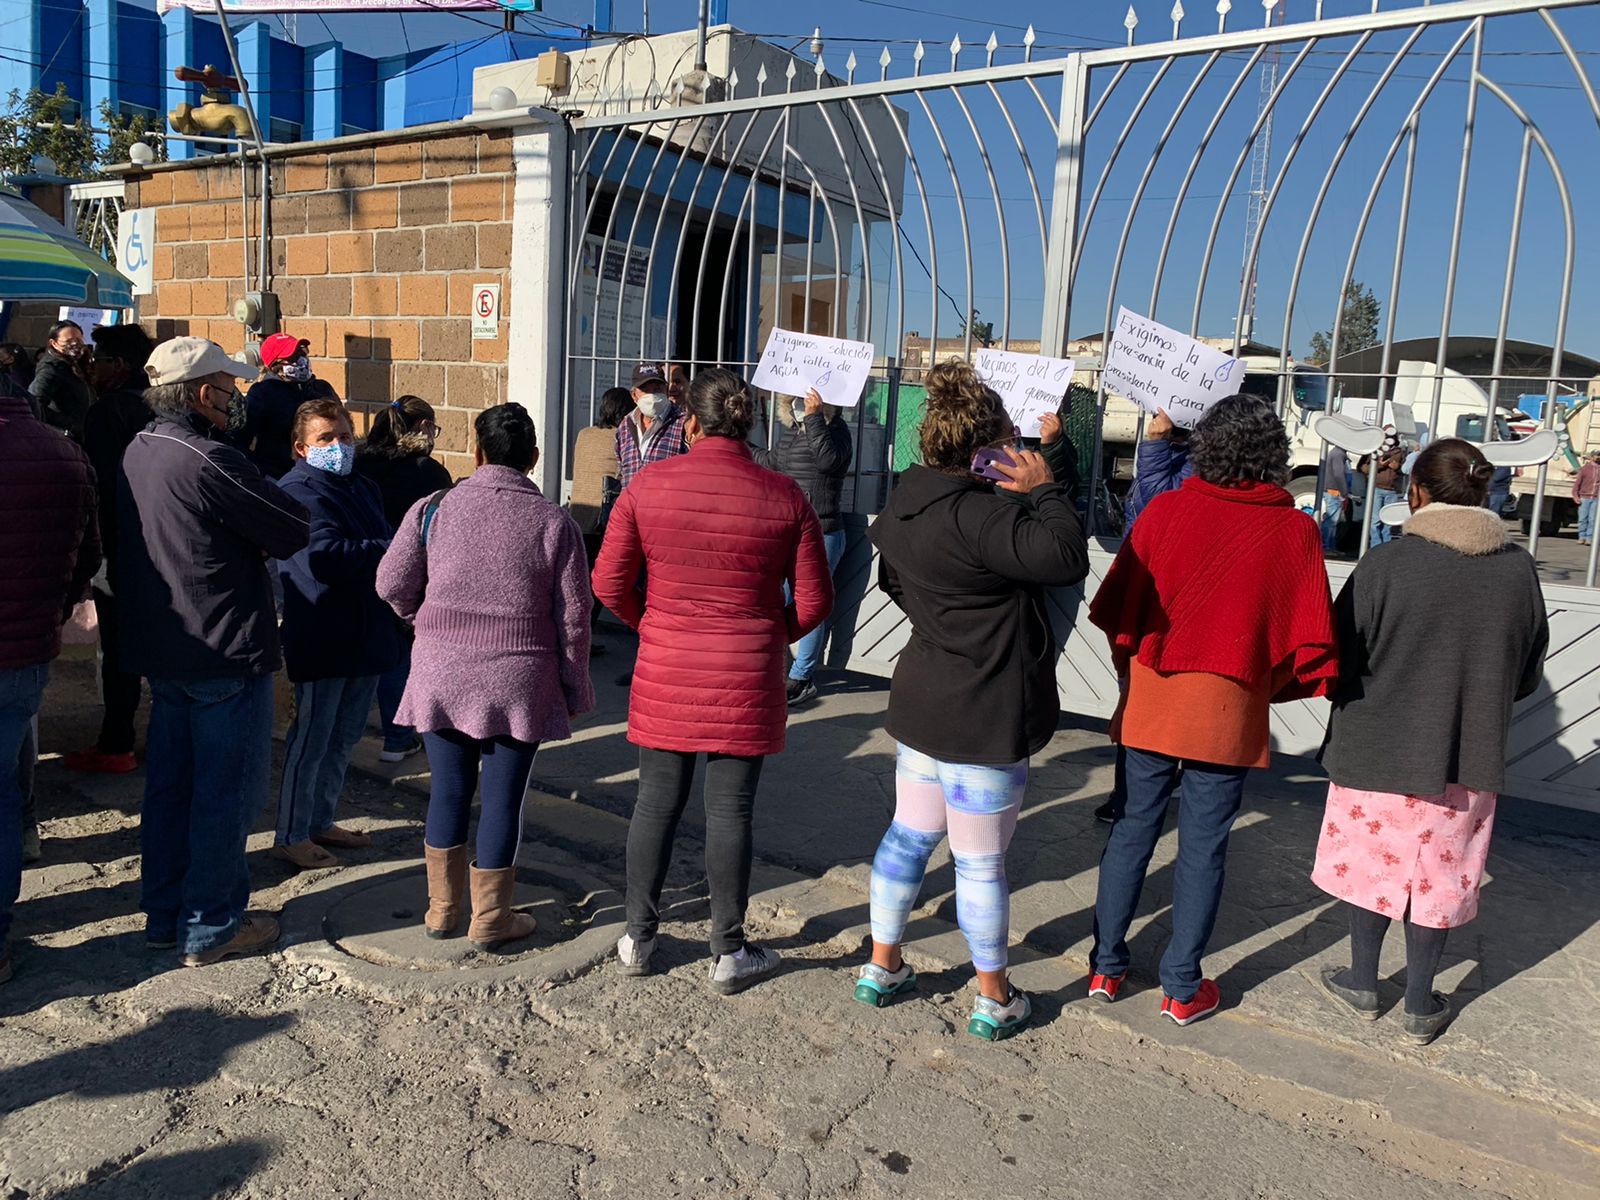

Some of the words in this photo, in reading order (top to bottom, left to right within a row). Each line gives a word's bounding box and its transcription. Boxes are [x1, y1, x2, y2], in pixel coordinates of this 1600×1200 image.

[775, 332, 818, 351] Exigimos
[1119, 315, 1177, 352] Exigimos
[1186, 344, 1199, 366] la
[767, 350, 775, 358] a
[784, 351, 793, 363] la
[770, 365, 799, 377] AGUA
[1171, 363, 1190, 382] de
[1200, 373, 1214, 391] la
[1168, 395, 1205, 411] para
